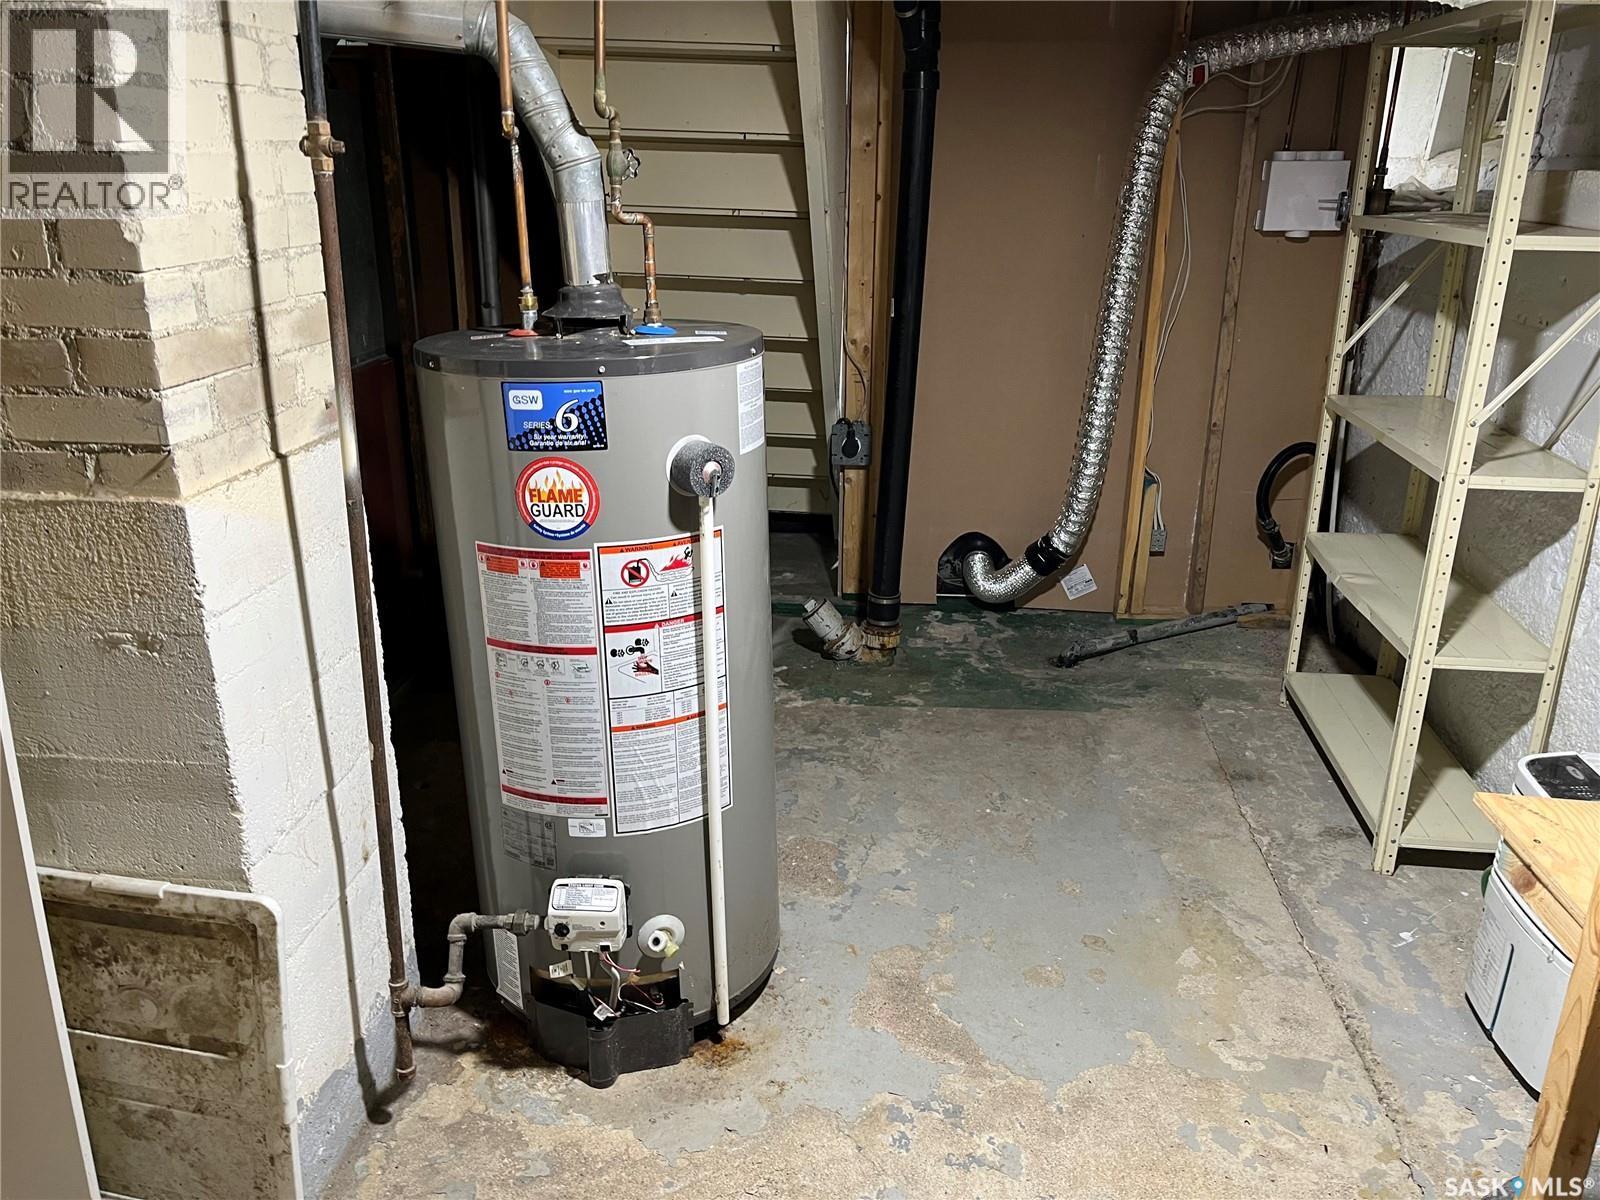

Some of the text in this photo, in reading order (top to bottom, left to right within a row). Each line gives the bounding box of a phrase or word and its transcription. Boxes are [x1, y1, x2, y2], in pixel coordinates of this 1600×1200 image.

[512, 395, 539, 405] GSW
[523, 398, 579, 432] SERIES 6
[543, 433, 557, 441] year
[528, 488, 583, 503] FLAME
[624, 545, 654, 553] WARNING
[661, 618, 685, 627] DANGER
